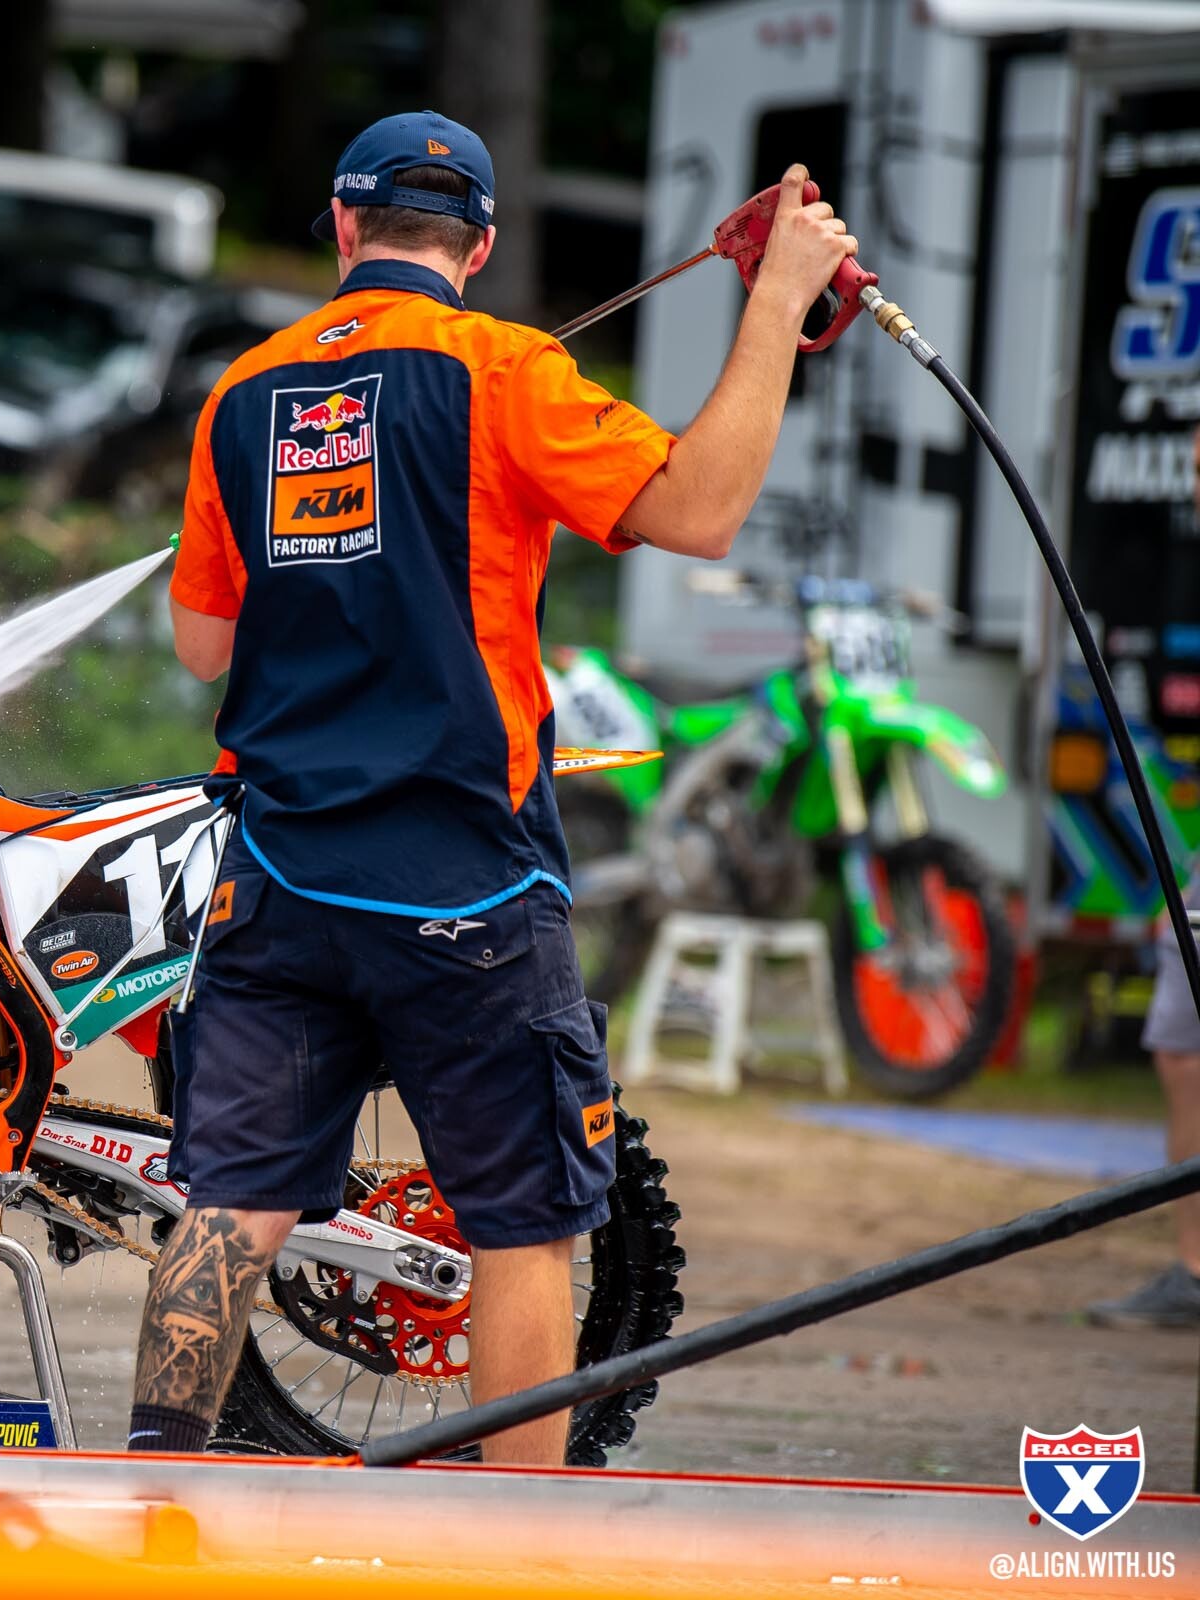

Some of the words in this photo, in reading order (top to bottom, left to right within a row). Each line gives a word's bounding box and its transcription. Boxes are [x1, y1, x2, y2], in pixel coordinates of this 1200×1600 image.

[346, 173, 378, 190] RACING
[276, 433, 332, 473] Red
[333, 423, 372, 467] Bull
[290, 483, 366, 520] KTM
[273, 537, 337, 557] FACTORY
[340, 527, 375, 553] RACING
[56, 960, 80, 974] Twin
[80, 956, 96, 968] Air
[589, 1110, 611, 1135] KTM
[328, 1219, 373, 1241] brembo
